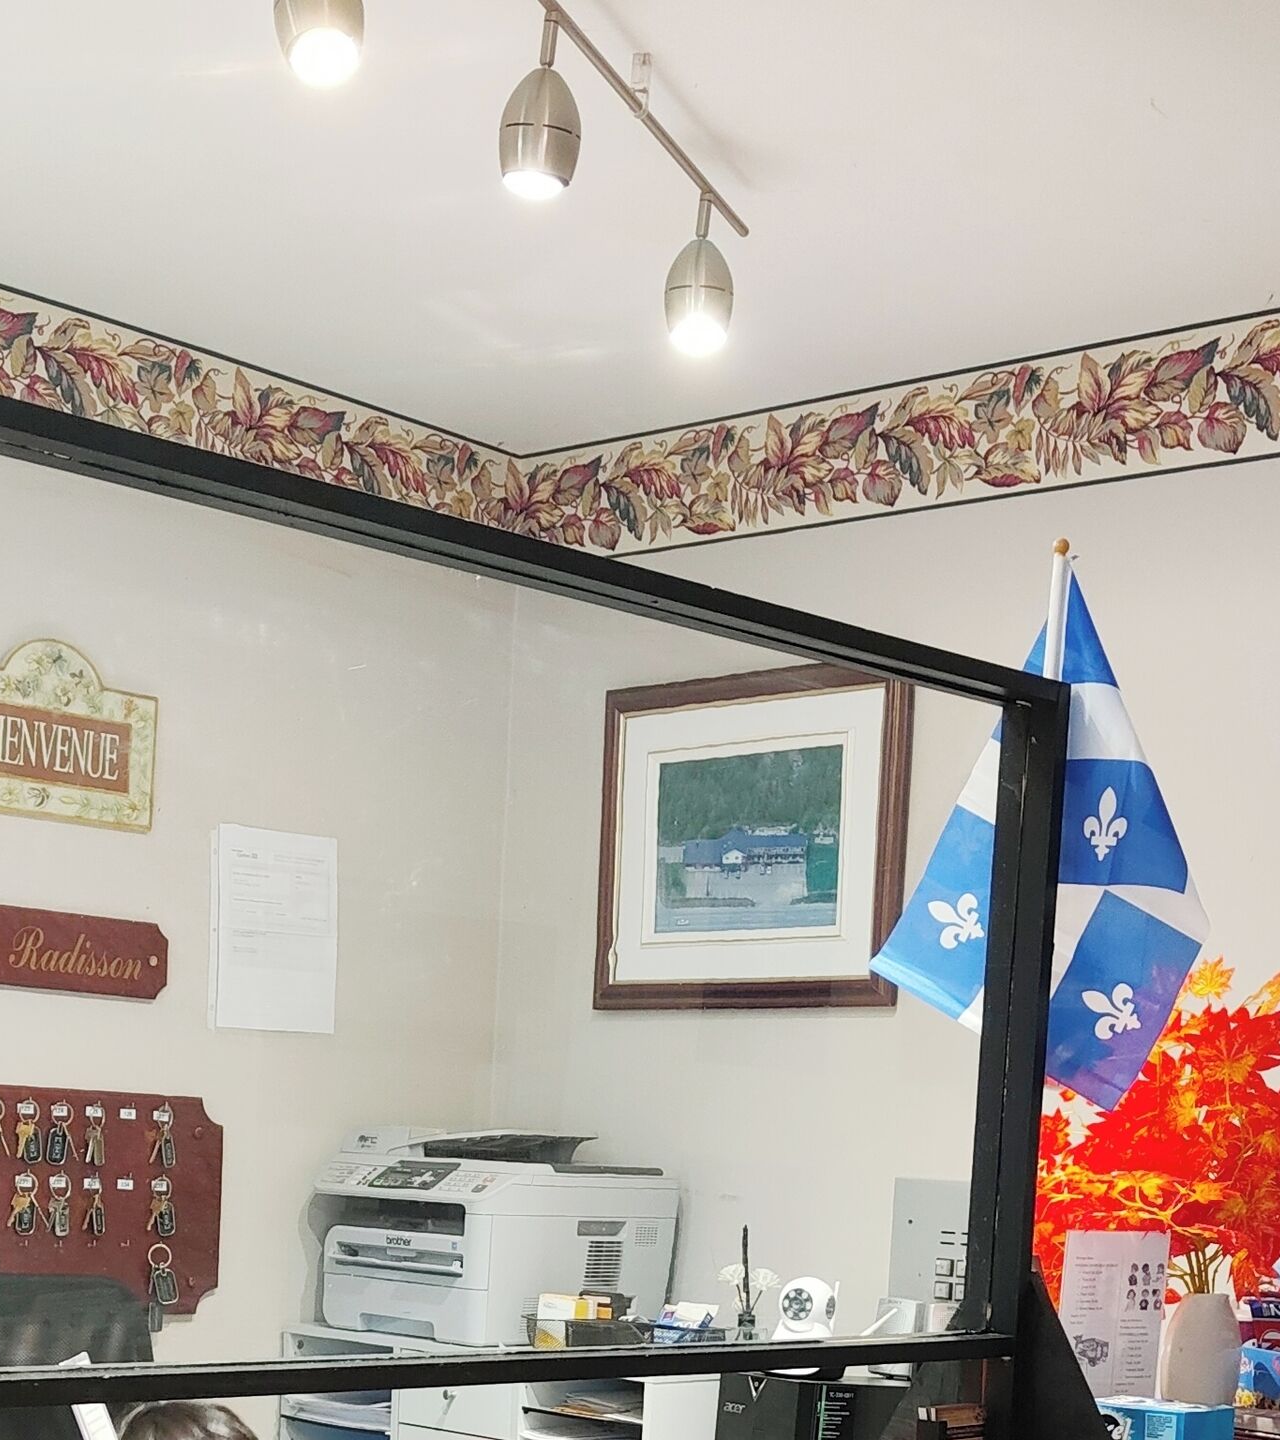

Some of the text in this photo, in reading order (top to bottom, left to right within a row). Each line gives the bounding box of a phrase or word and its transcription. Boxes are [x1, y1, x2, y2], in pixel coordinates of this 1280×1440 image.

[8, 926, 142, 981] Radisson
[386, 1234, 412, 1247] brother
[723, 1402, 746, 1414] acer
